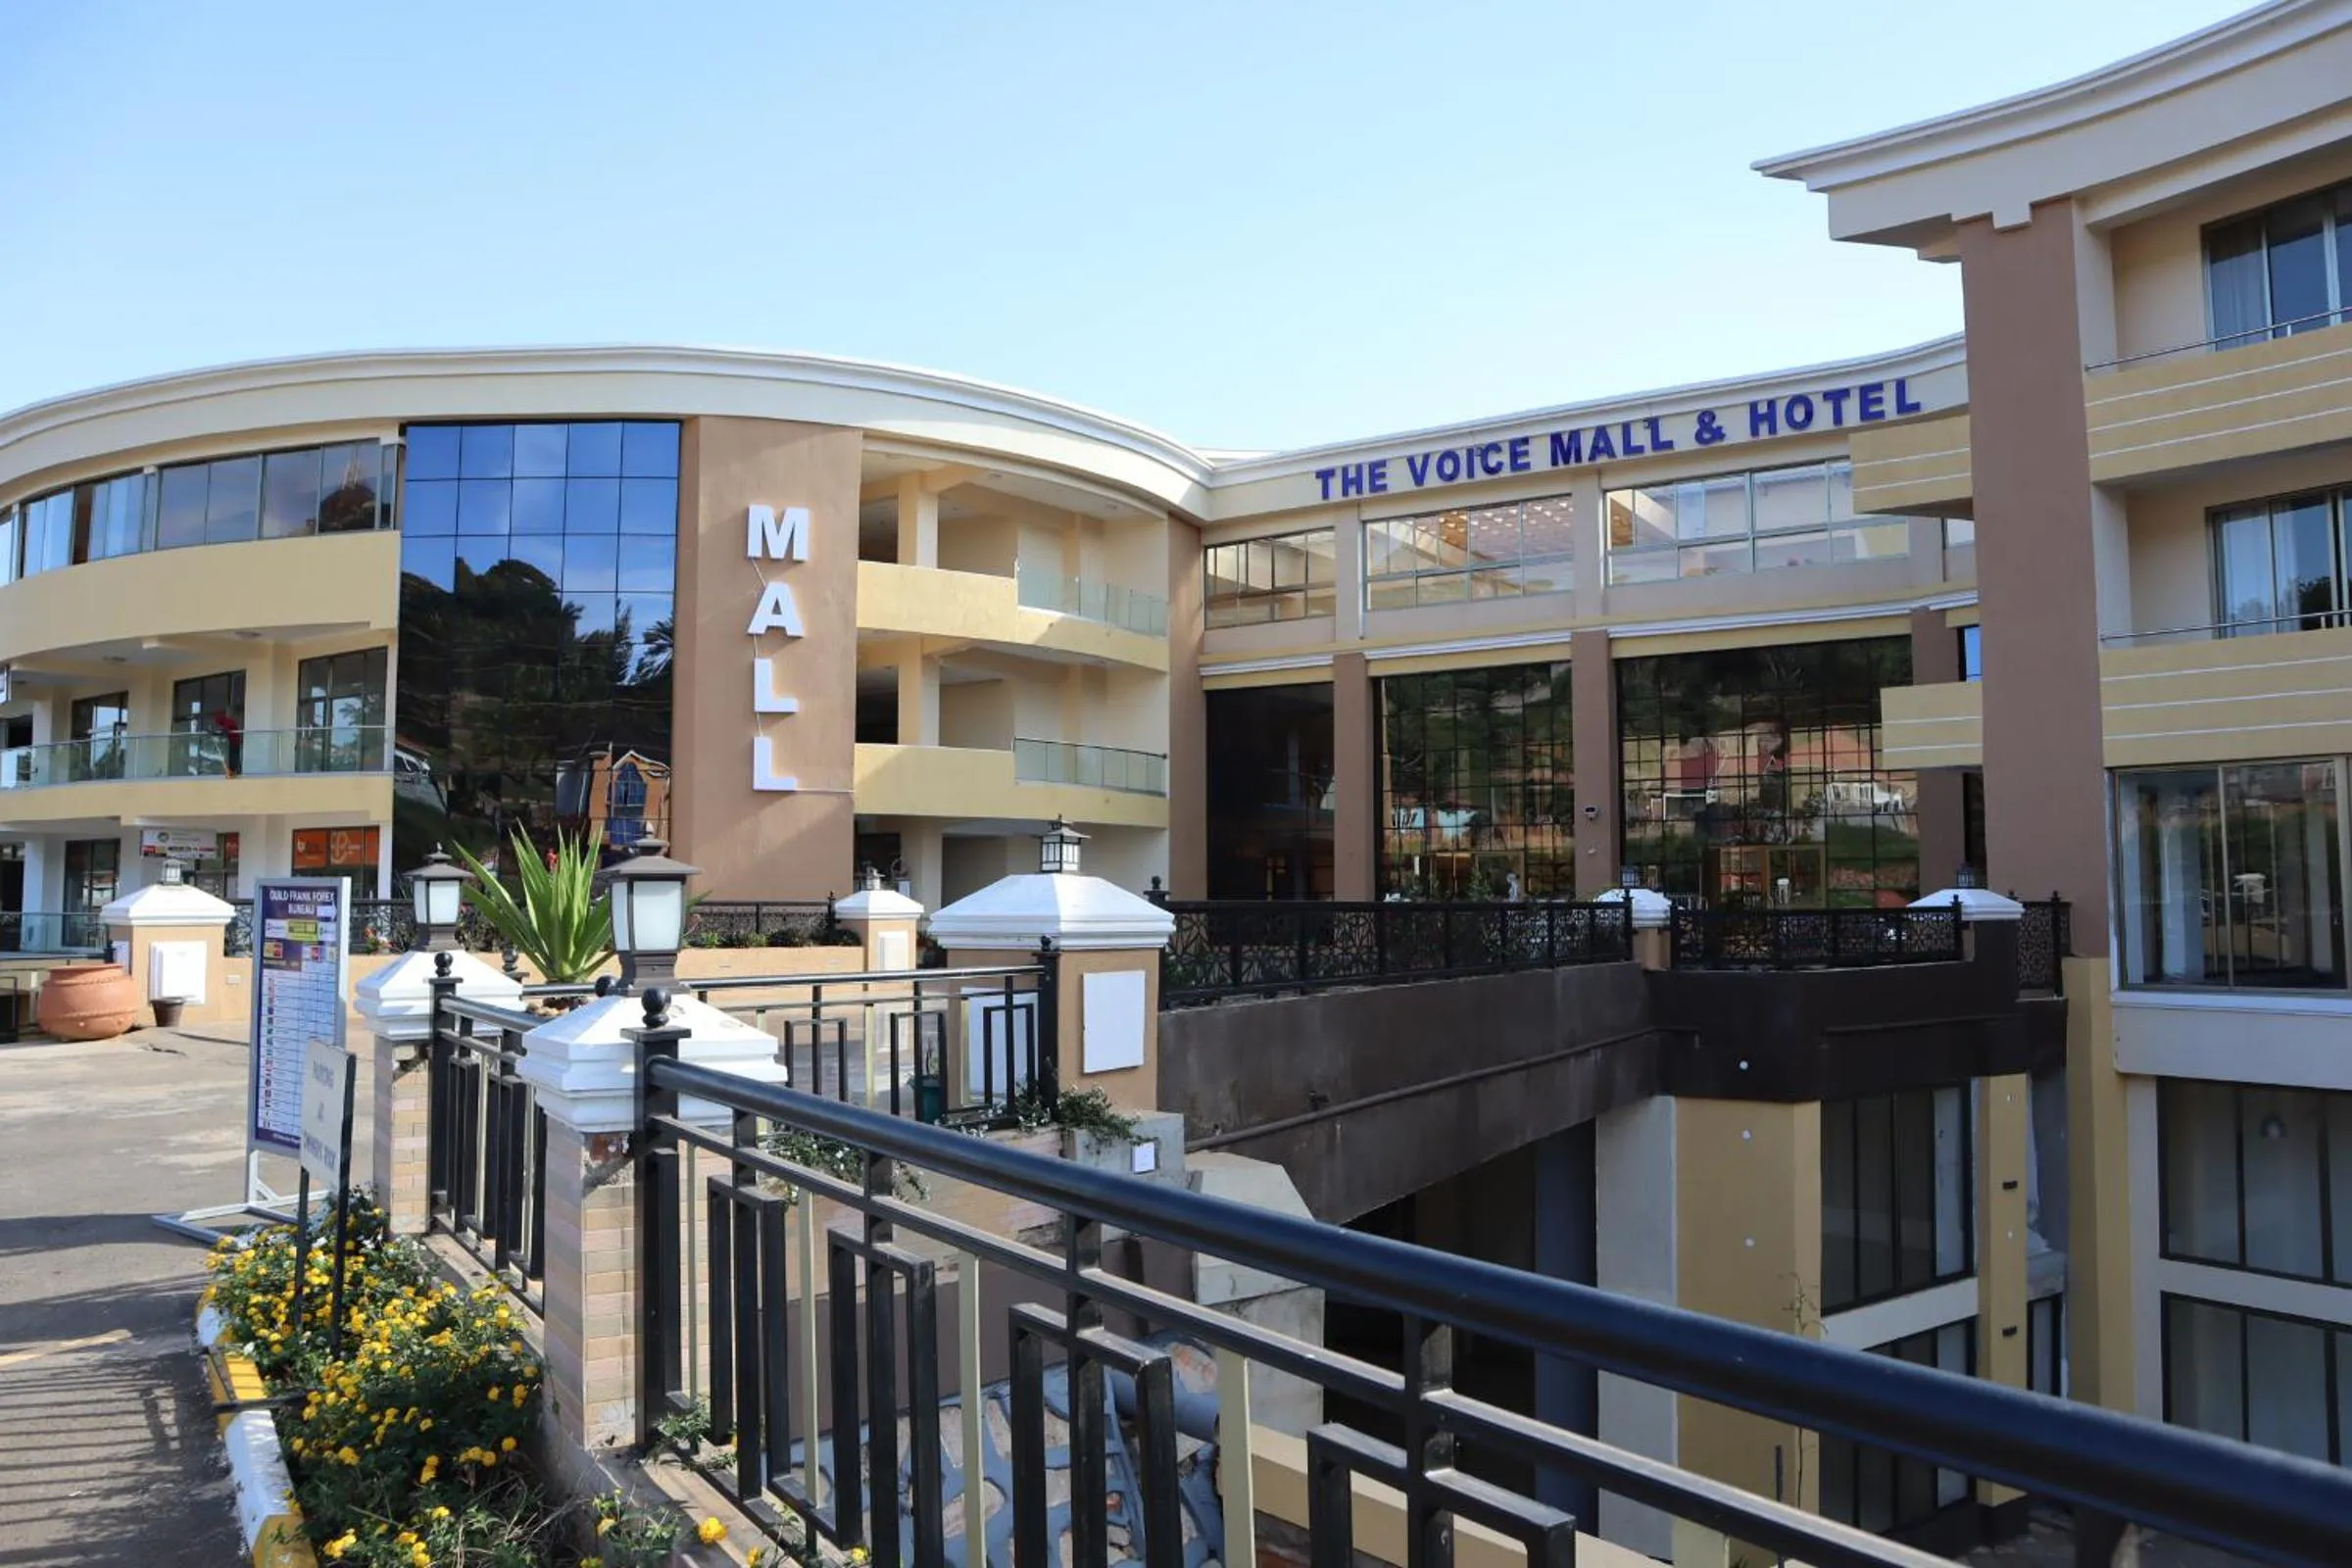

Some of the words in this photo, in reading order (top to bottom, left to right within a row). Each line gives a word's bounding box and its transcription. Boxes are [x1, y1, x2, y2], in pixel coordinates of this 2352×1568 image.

[1315, 460, 1388, 500] THE
[1406, 437, 1531, 487] VOICE
[1549, 416, 1673, 466] MALL
[1694, 410, 1726, 445] &
[1749, 378, 1921, 437] HOTEL
[747, 504, 809, 791] MALL
